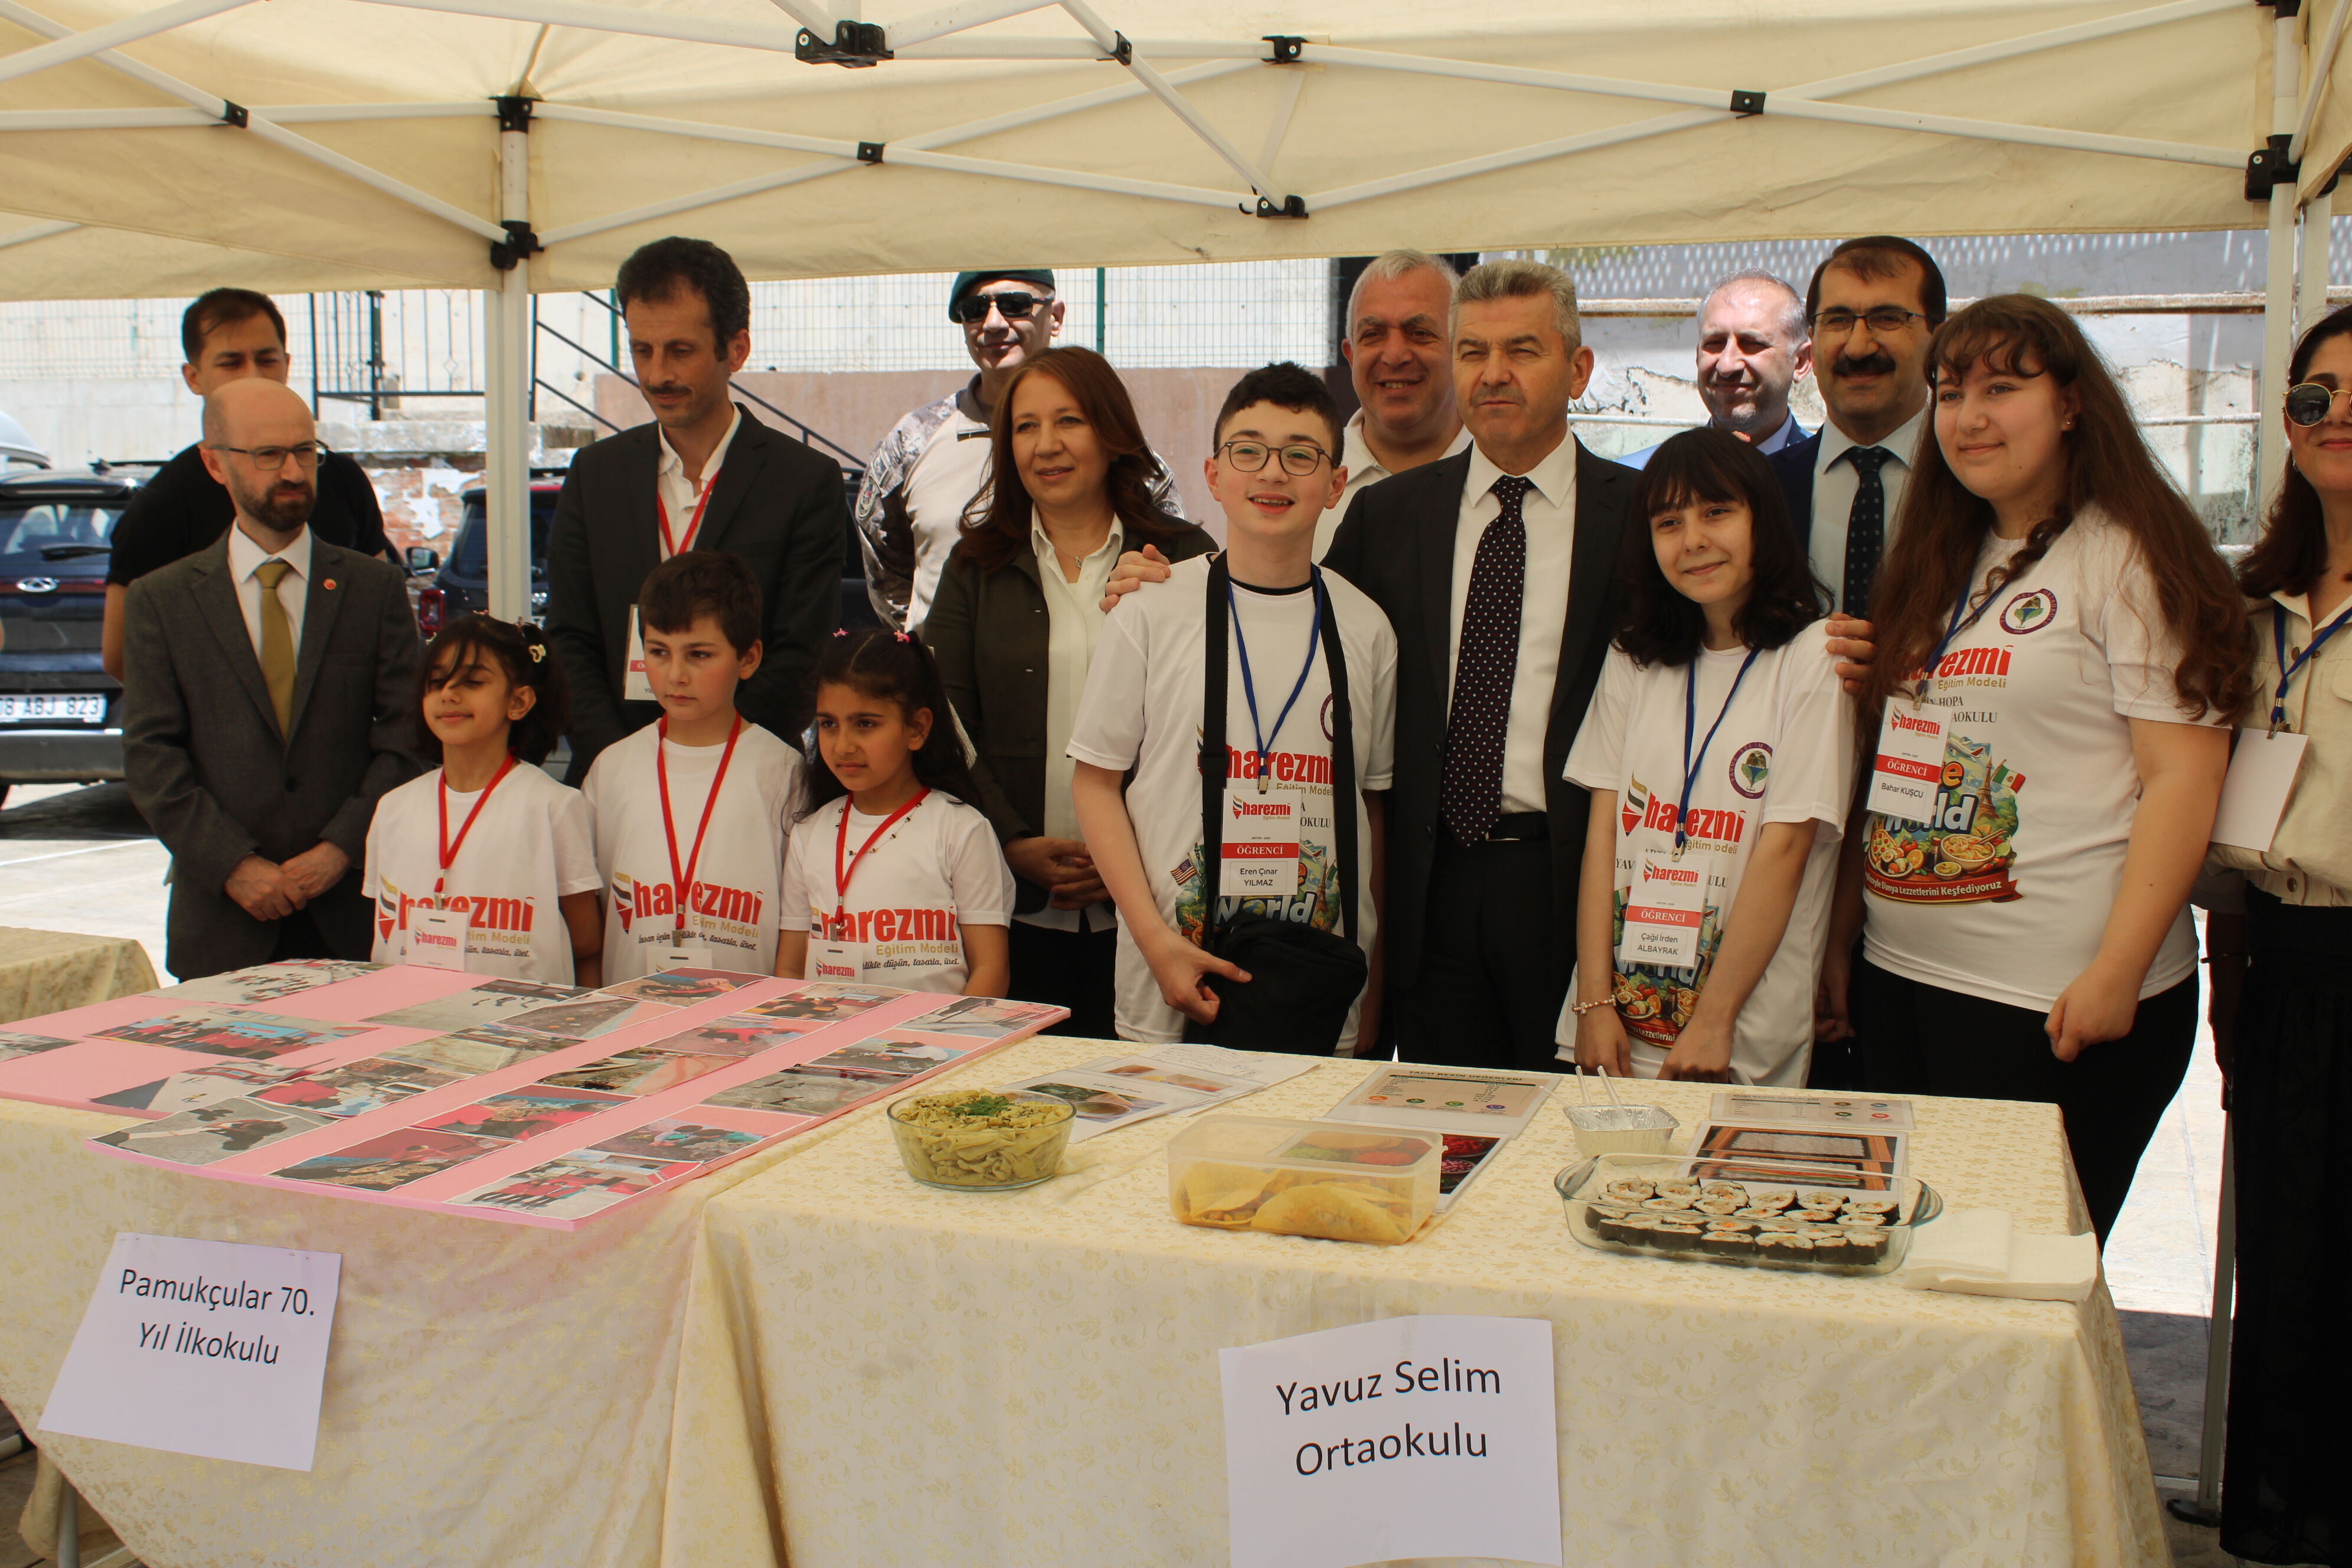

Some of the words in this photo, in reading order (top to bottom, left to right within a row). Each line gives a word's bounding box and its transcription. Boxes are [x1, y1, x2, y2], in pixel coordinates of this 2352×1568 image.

[1938, 680, 1964, 691] Eğitim
[1966, 677, 2007, 688] Modeli
[67, 697, 99, 715] 823
[1951, 711, 1998, 723] AOKULU
[1887, 759, 1928, 776] ÖĞRENCİ
[1881, 783, 1900, 793] Bahar
[1243, 801, 1291, 815] harezmi
[1237, 845, 1283, 855] ÖĞRENCİ
[1259, 868, 1278, 876] Çınar
[1651, 865, 1699, 883] harezmi
[1899, 886, 1939, 896] Lezzetlerini
[1941, 881, 2002, 896] Keşfediyoruz
[1641, 909, 1686, 923] ÖĞRENCİ
[720, 922, 759, 939] Modeli
[1641, 932, 1659, 942] Çağıl
[1660, 933, 1678, 943] İrden
[492, 932, 531, 945] Modeli
[876, 945, 915, 957] Eğitim
[920, 943, 958, 955] Modeli
[1637, 945, 1678, 955] ALBAYRAK
[119, 1269, 272, 1311] Pamukçular
[280, 1286, 315, 1316] 70.
[139, 1322, 171, 1351] Yıl
[175, 1321, 279, 1364] İlkokulu
[1276, 1373, 1382, 1415] Yavuz
[1395, 1357, 1500, 1394] Selim
[1296, 1422, 1487, 1476] Ortaokulu
